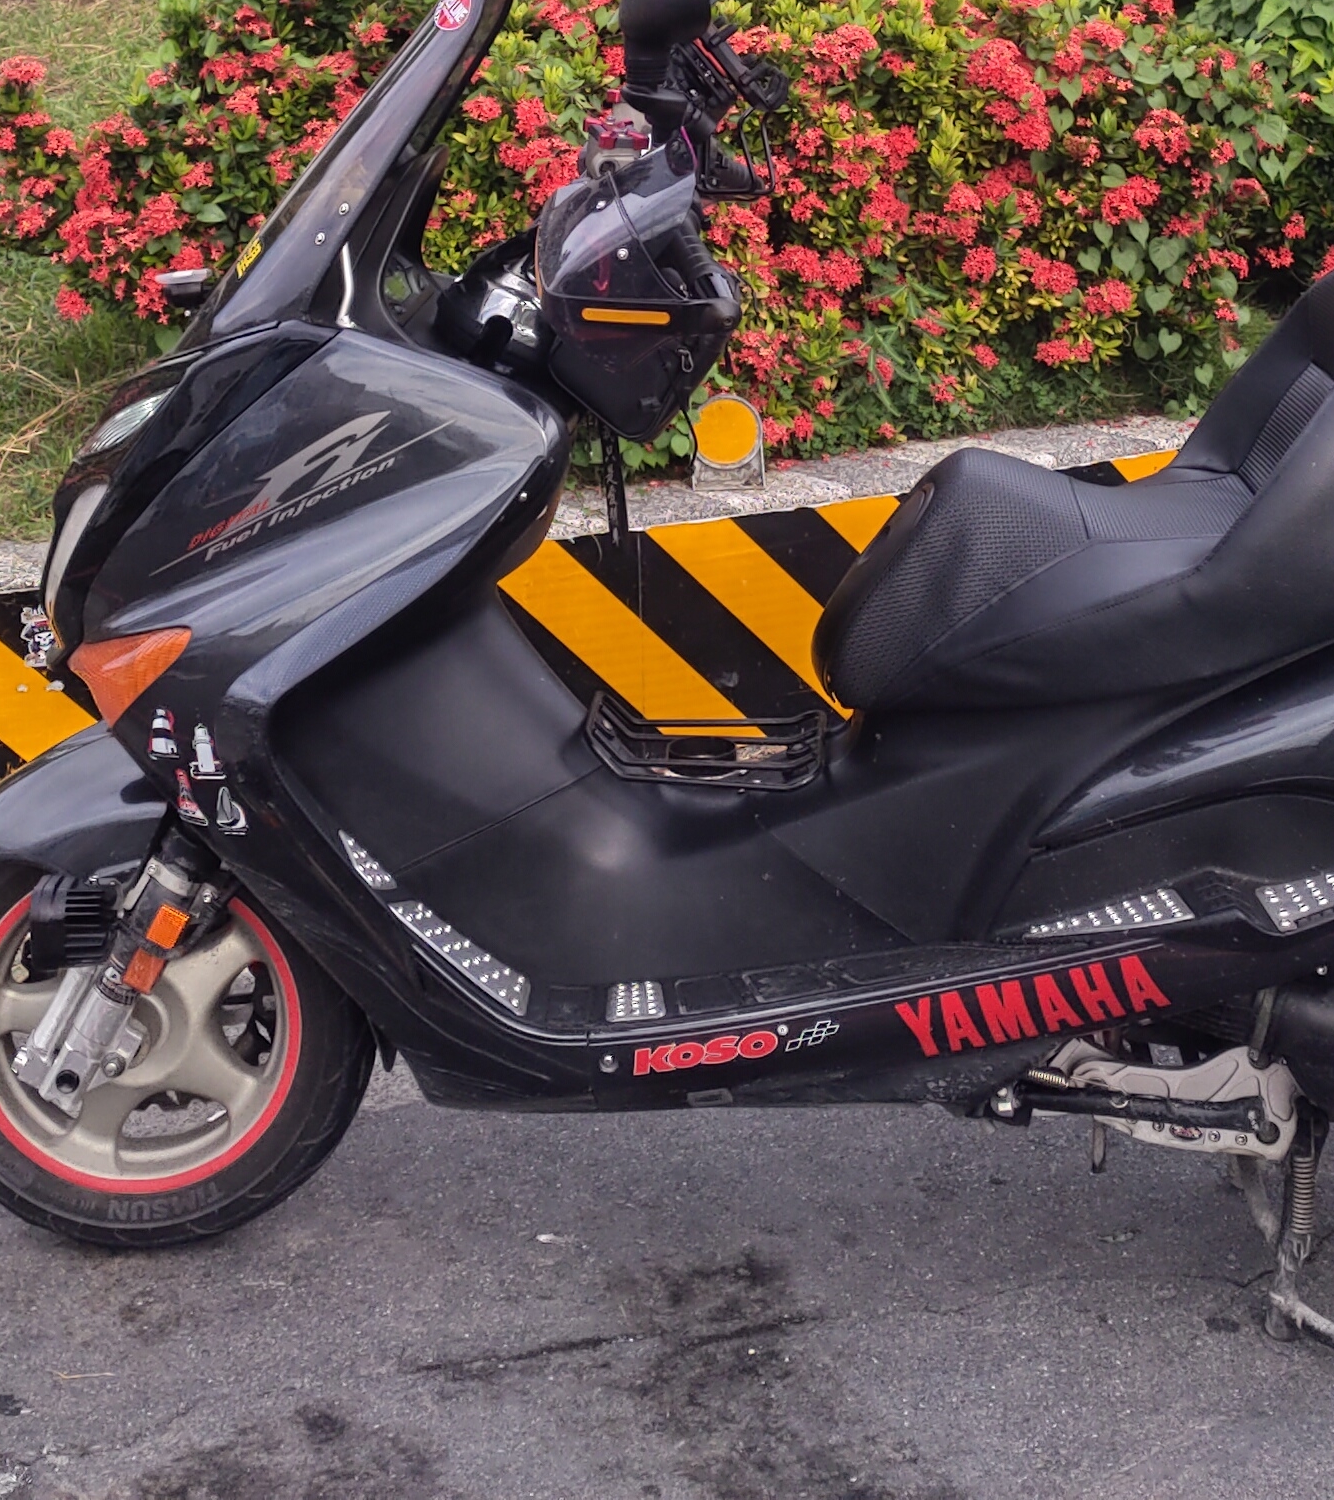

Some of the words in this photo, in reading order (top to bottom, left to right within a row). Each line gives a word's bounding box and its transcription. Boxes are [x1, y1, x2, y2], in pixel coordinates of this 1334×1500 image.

[204, 524, 260, 562] Fuel
[268, 457, 395, 528] Injection
[633, 1031, 779, 1076] KOSO
[895, 954, 1171, 1057] YAMAHA
